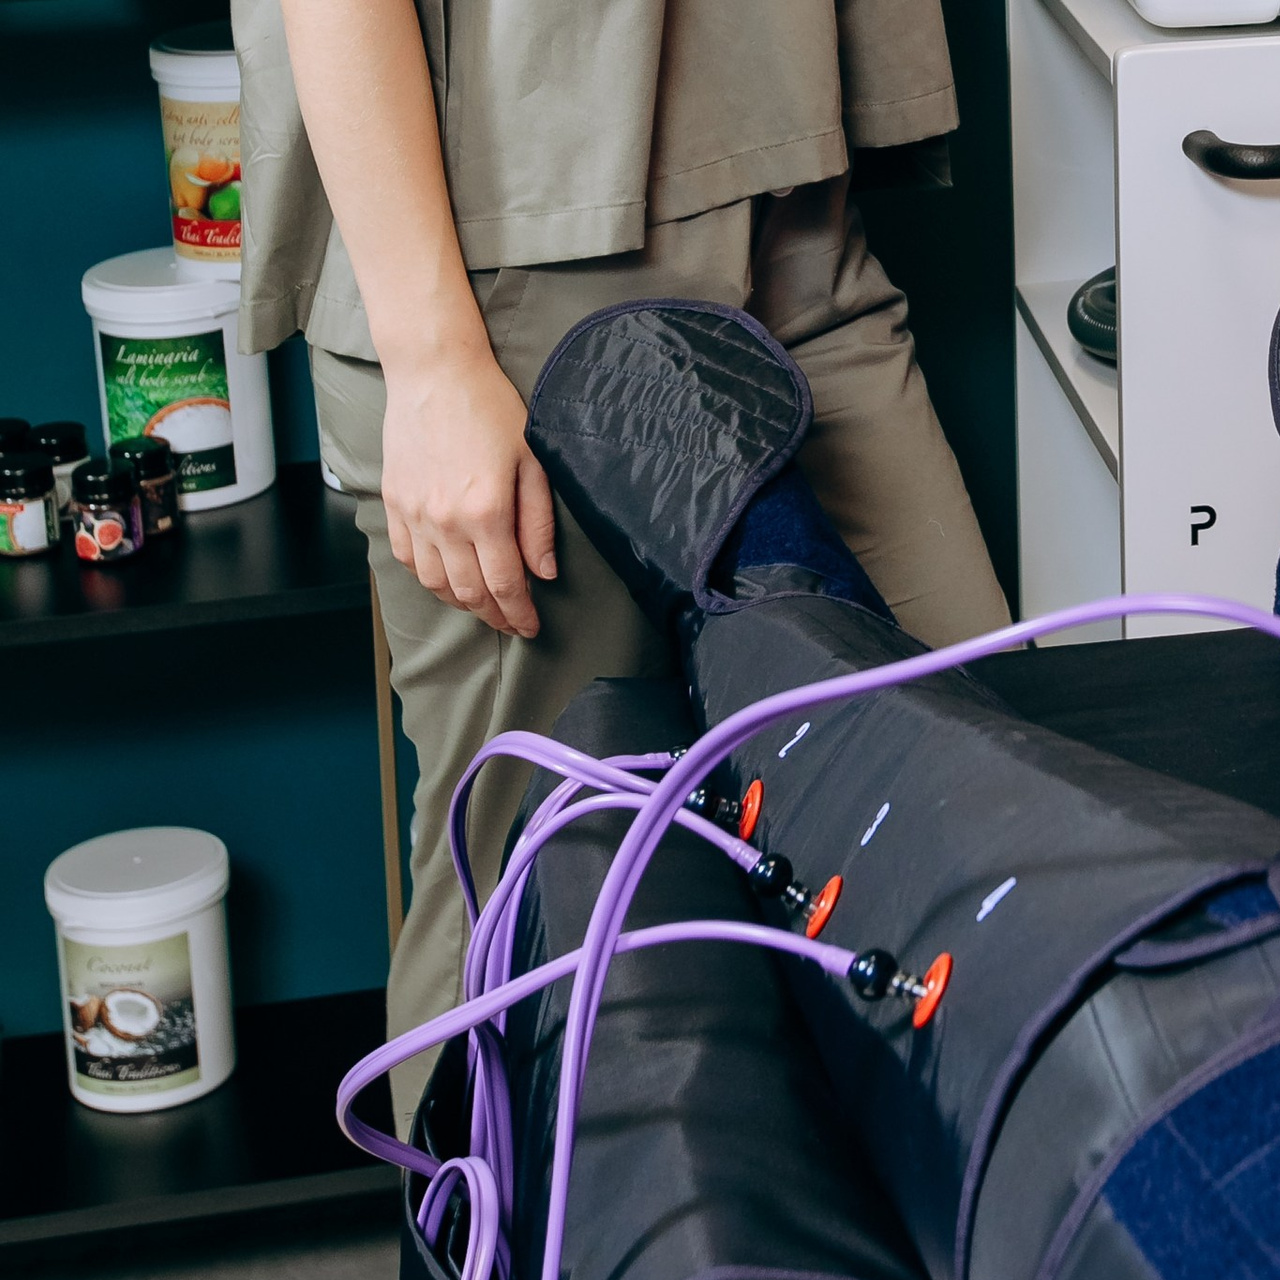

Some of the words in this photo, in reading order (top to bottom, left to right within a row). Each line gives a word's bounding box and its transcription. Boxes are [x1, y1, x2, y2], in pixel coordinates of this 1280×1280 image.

[219, 136, 240, 146] scru
[181, 220, 200, 243] Thai
[204, 222, 241, 245] Tradit
[115, 344, 199, 366] Laminaria
